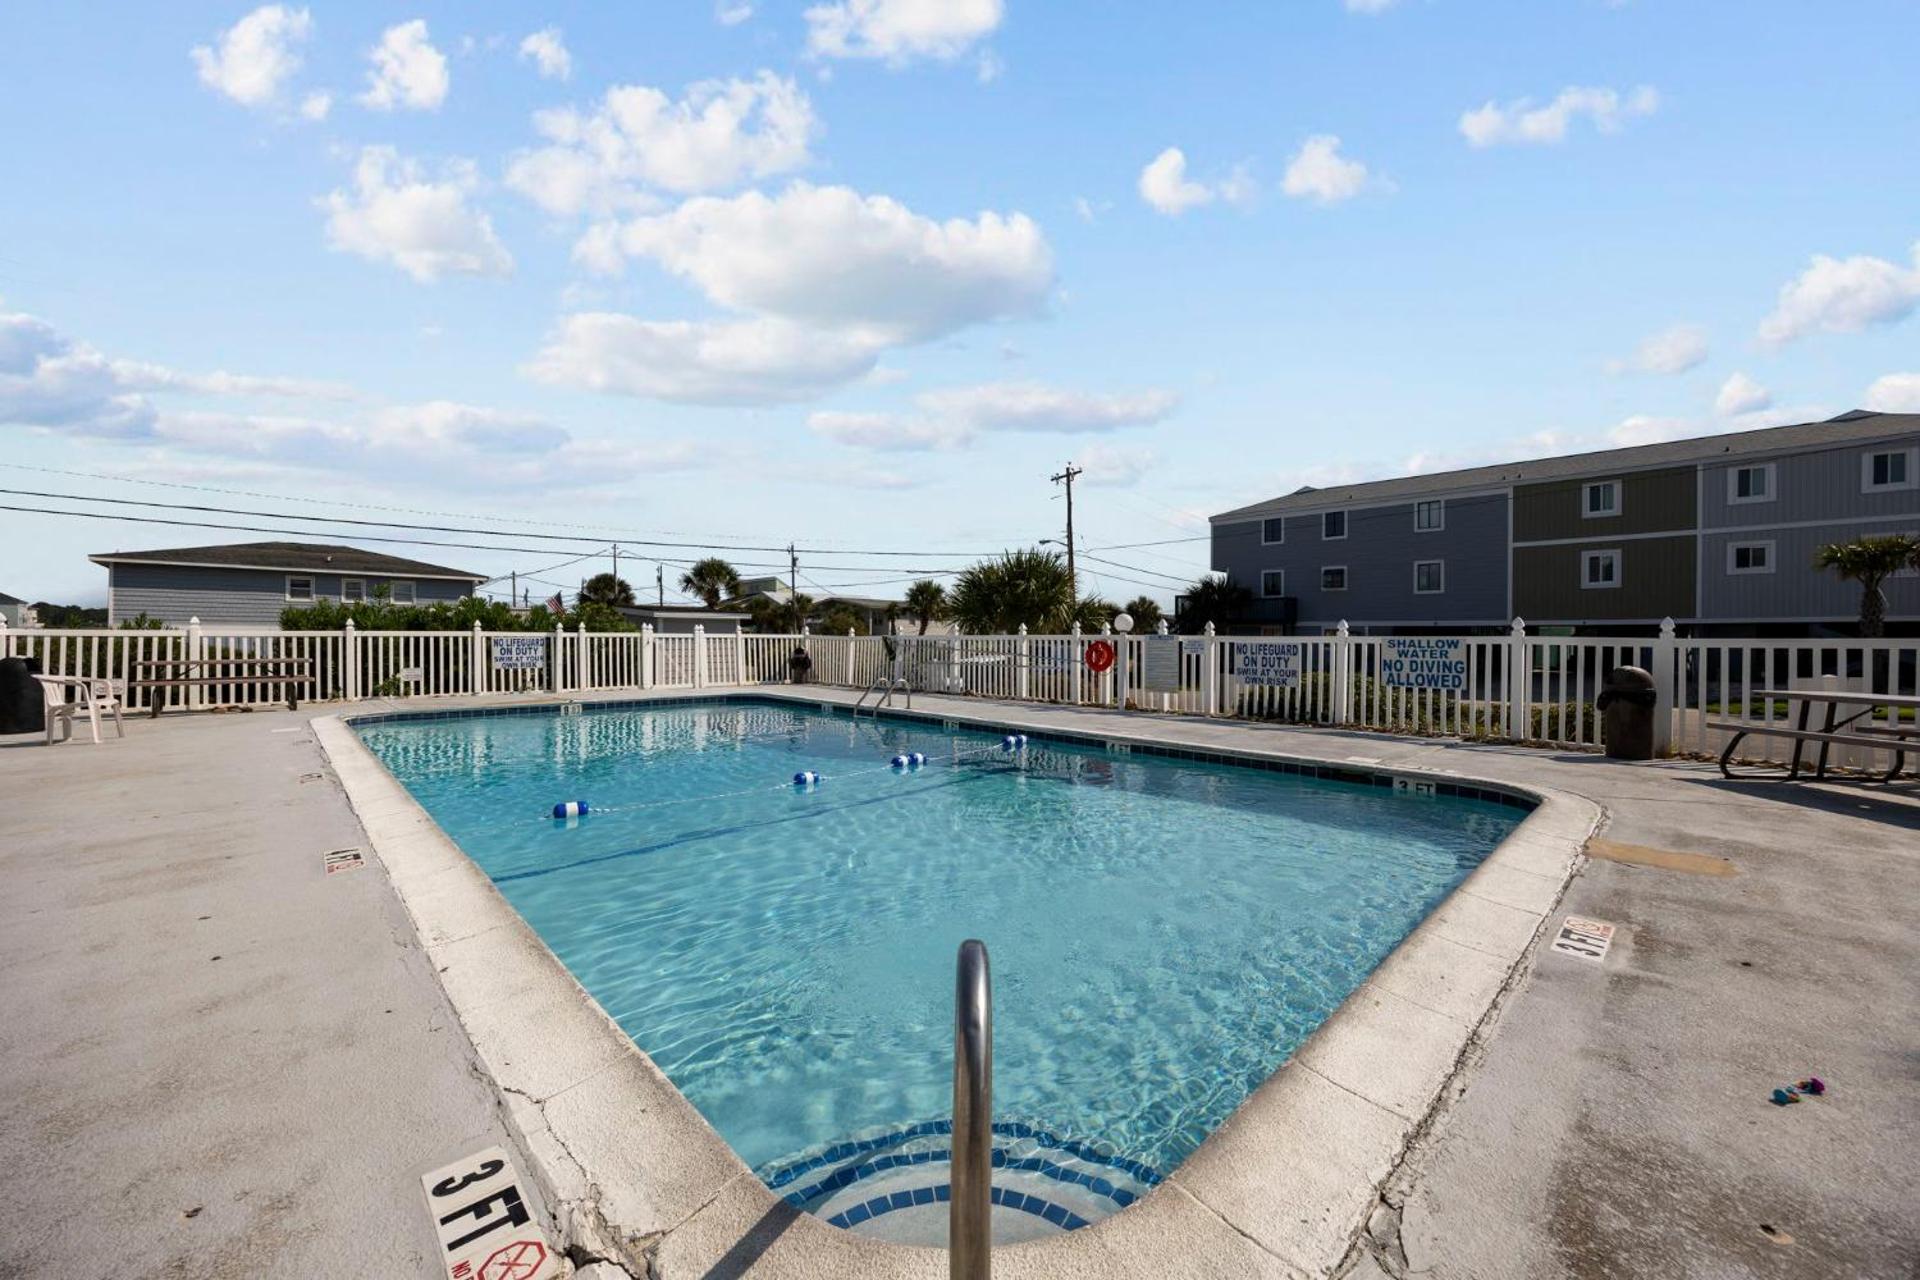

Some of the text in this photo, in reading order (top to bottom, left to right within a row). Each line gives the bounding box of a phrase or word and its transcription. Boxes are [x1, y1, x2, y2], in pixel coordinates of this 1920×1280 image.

[494, 638, 503, 647] NO
[1387, 639, 1460, 649] SHALLOW
[500, 647, 538, 655] ON DUTY
[1236, 643, 1298, 656] NO LIFEGUARD
[1397, 649, 1449, 659] WATER
[1244, 656, 1290, 668] ON DUTY
[1383, 659, 1465, 674] NO DIVING
[1261, 668, 1271, 676] AT
[1274, 669, 1297, 678] YOUR
[1244, 676, 1288, 686] OWN RISK
[1386, 673, 1462, 688] ALLOWED
[431, 1159, 504, 1197] 3
[451, 1260, 471, 1279] NO
